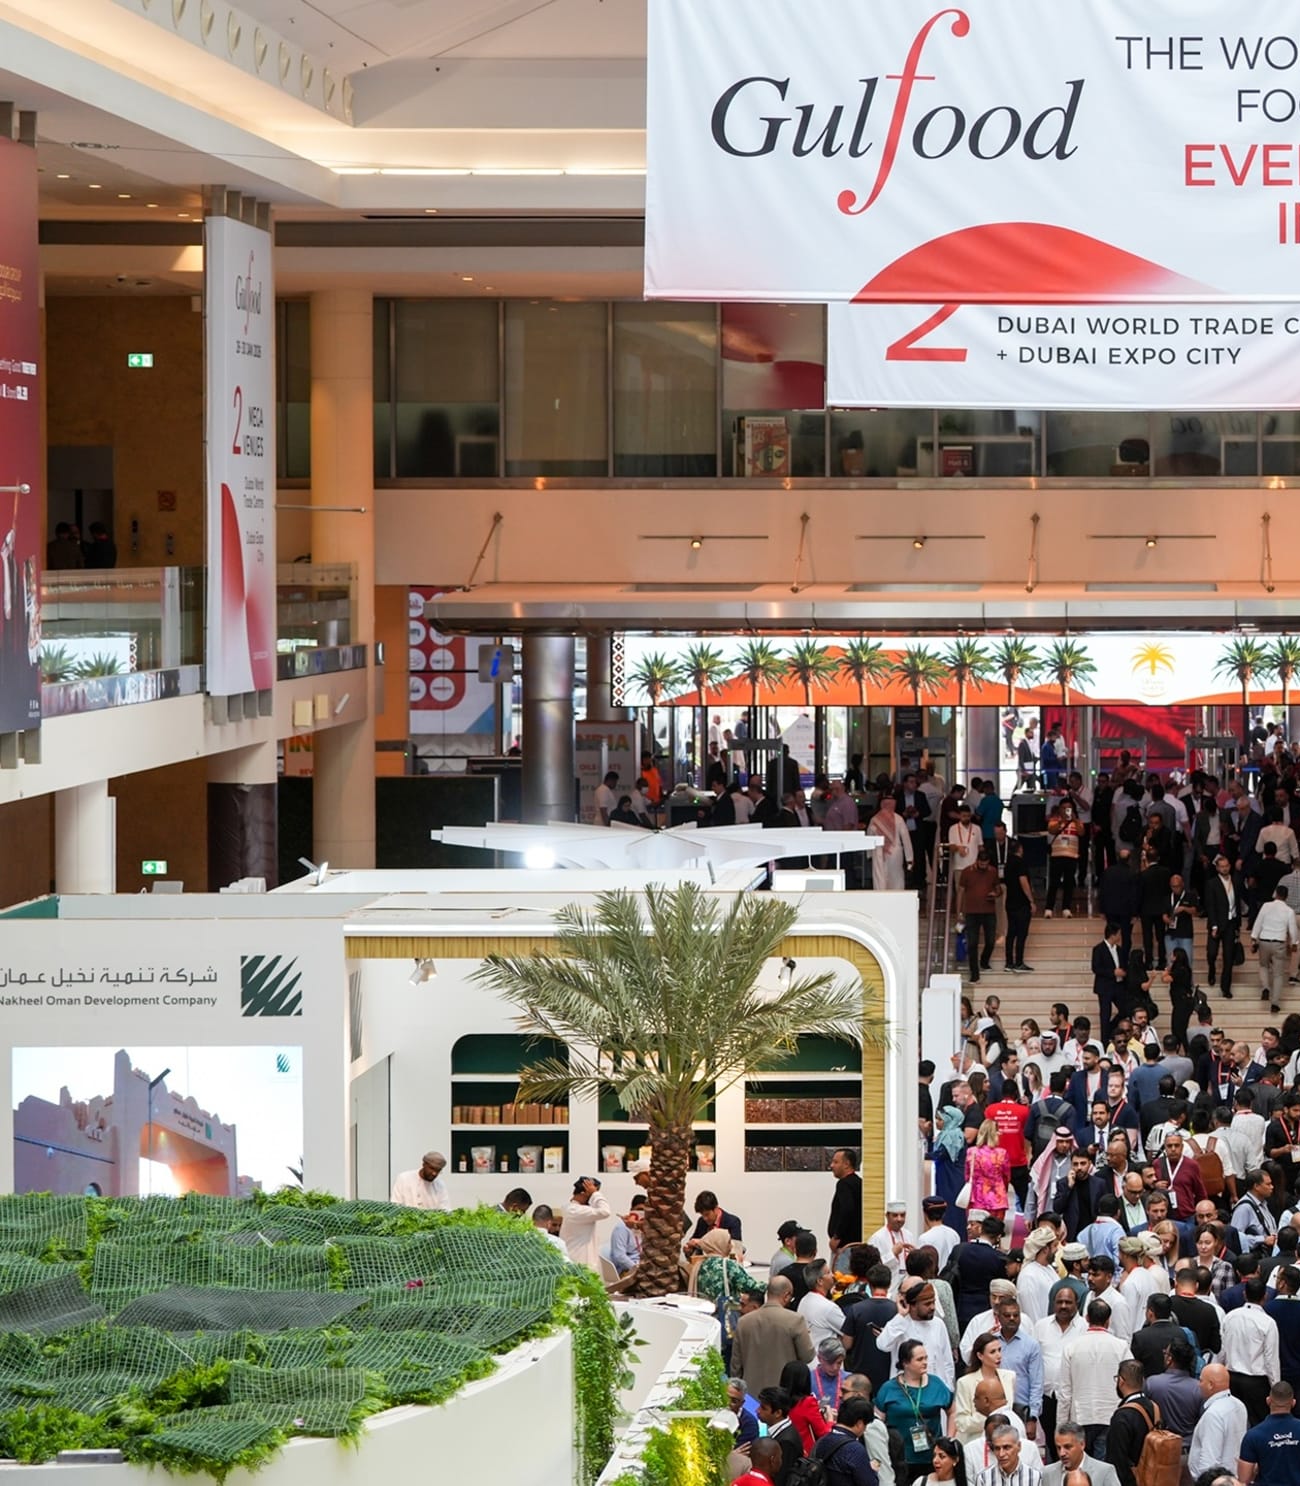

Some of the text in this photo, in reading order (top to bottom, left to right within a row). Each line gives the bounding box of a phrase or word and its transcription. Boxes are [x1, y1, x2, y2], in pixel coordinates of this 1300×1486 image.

[1116, 36, 1204, 71] THE
[711, 8, 1085, 216] Gulfood
[997, 316, 1076, 334] DUBAI
[1086, 318, 1178, 336] WORLD
[1189, 318, 1275, 336] TRADE
[1019, 347, 1097, 365] DUBAI
[1109, 348, 1175, 365] EXPO
[1186, 348, 1242, 366] CITY
[232, 385, 243, 455] 2
[51, 967, 95, 988] نخيل
[100, 967, 155, 988] تنمية
[159, 966, 218, 987] شركة
[46, 995, 82, 1006] Oman
[84, 994, 160, 1007] Development
[163, 995, 218, 1007] Company
